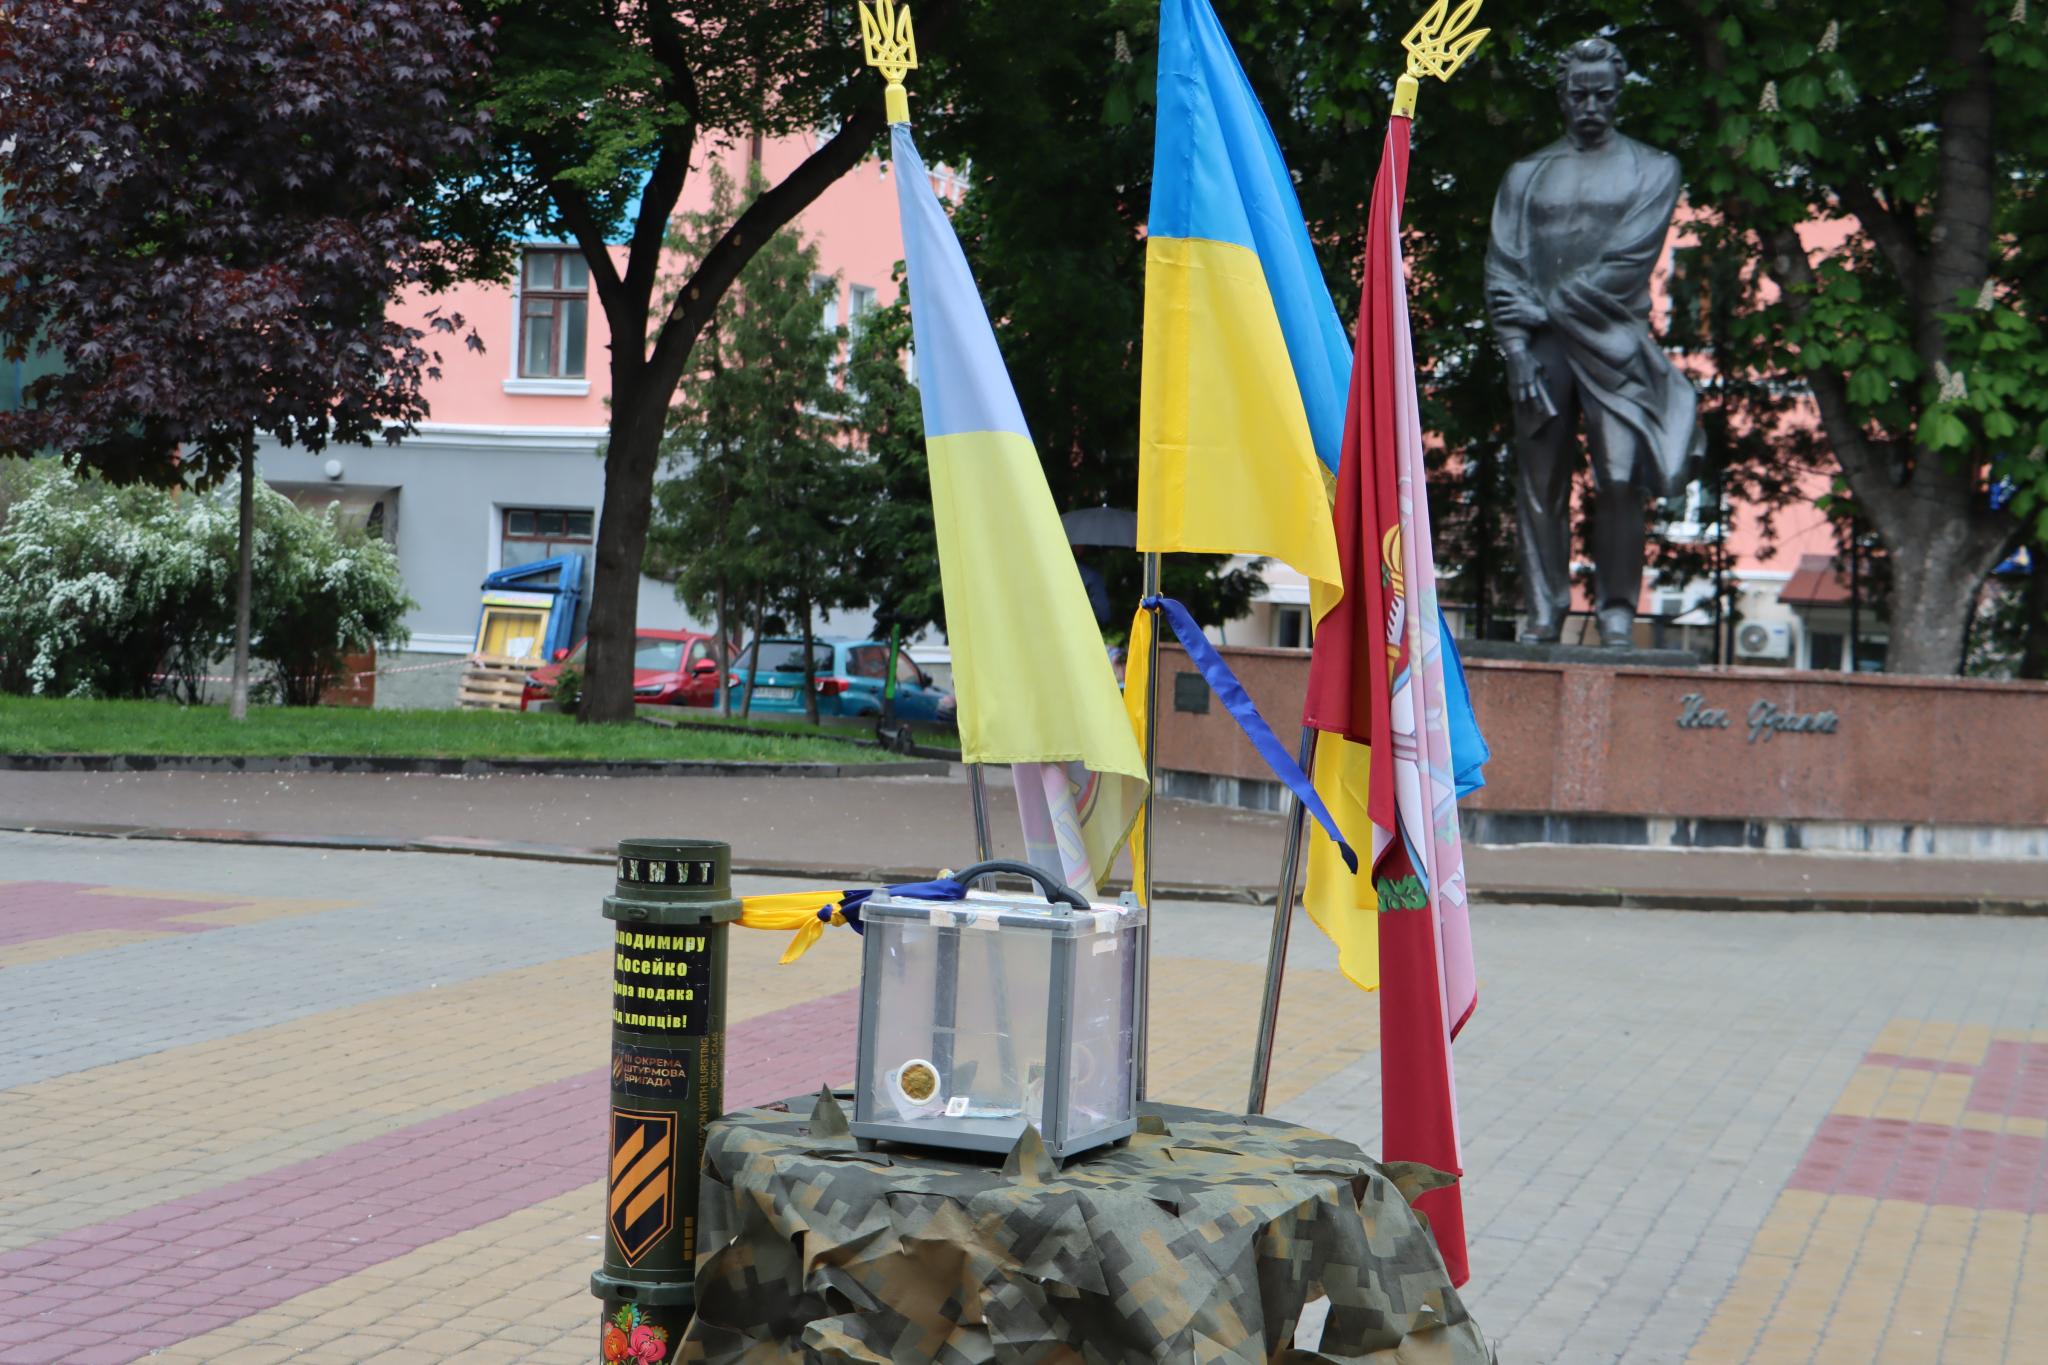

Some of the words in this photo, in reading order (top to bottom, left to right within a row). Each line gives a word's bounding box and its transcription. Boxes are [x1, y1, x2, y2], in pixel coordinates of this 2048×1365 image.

[618, 858, 711, 883] АХМУТ
[616, 930, 706, 953] олодимиру
[638, 986, 694, 1002] подяка
[624, 1012, 687, 1030] хлопців!
[634, 1056, 682, 1068] ОКРЕМА
[624, 1064, 686, 1078] ШТУРМОВА
[624, 1074, 672, 1087] БРИГАДА
